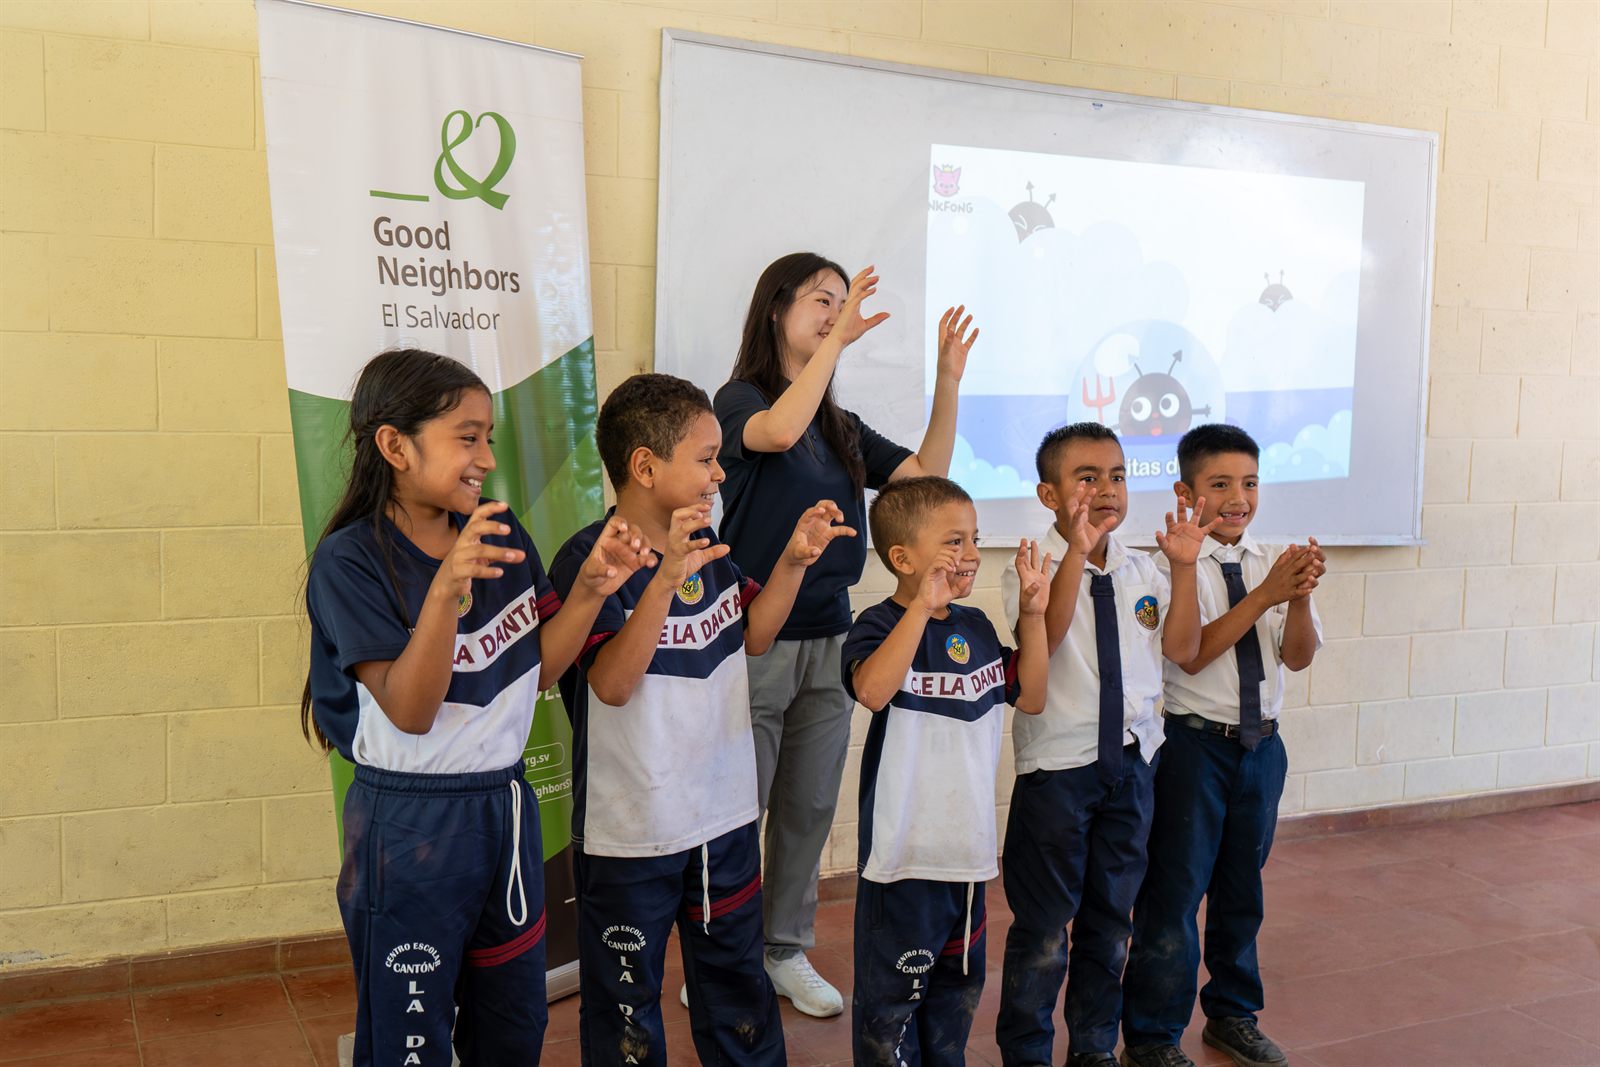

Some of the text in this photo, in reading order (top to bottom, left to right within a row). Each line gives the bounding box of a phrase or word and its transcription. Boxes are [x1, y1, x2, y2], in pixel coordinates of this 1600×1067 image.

[373, 216, 451, 251] Good
[377, 255, 521, 297] Neighbors
[381, 303, 501, 331] El Salvador
[453, 595, 539, 665] A DANTA
[673, 623, 697, 645] LA
[939, 676, 966, 696] LA
[607, 940, 642, 952] CANTÓN
[620, 925, 647, 948] ESCOLAR
[385, 942, 442, 969] CENTRO ESCOLAR
[895, 949, 918, 971] CENTRO
[392, 961, 435, 974] CANTÓN
